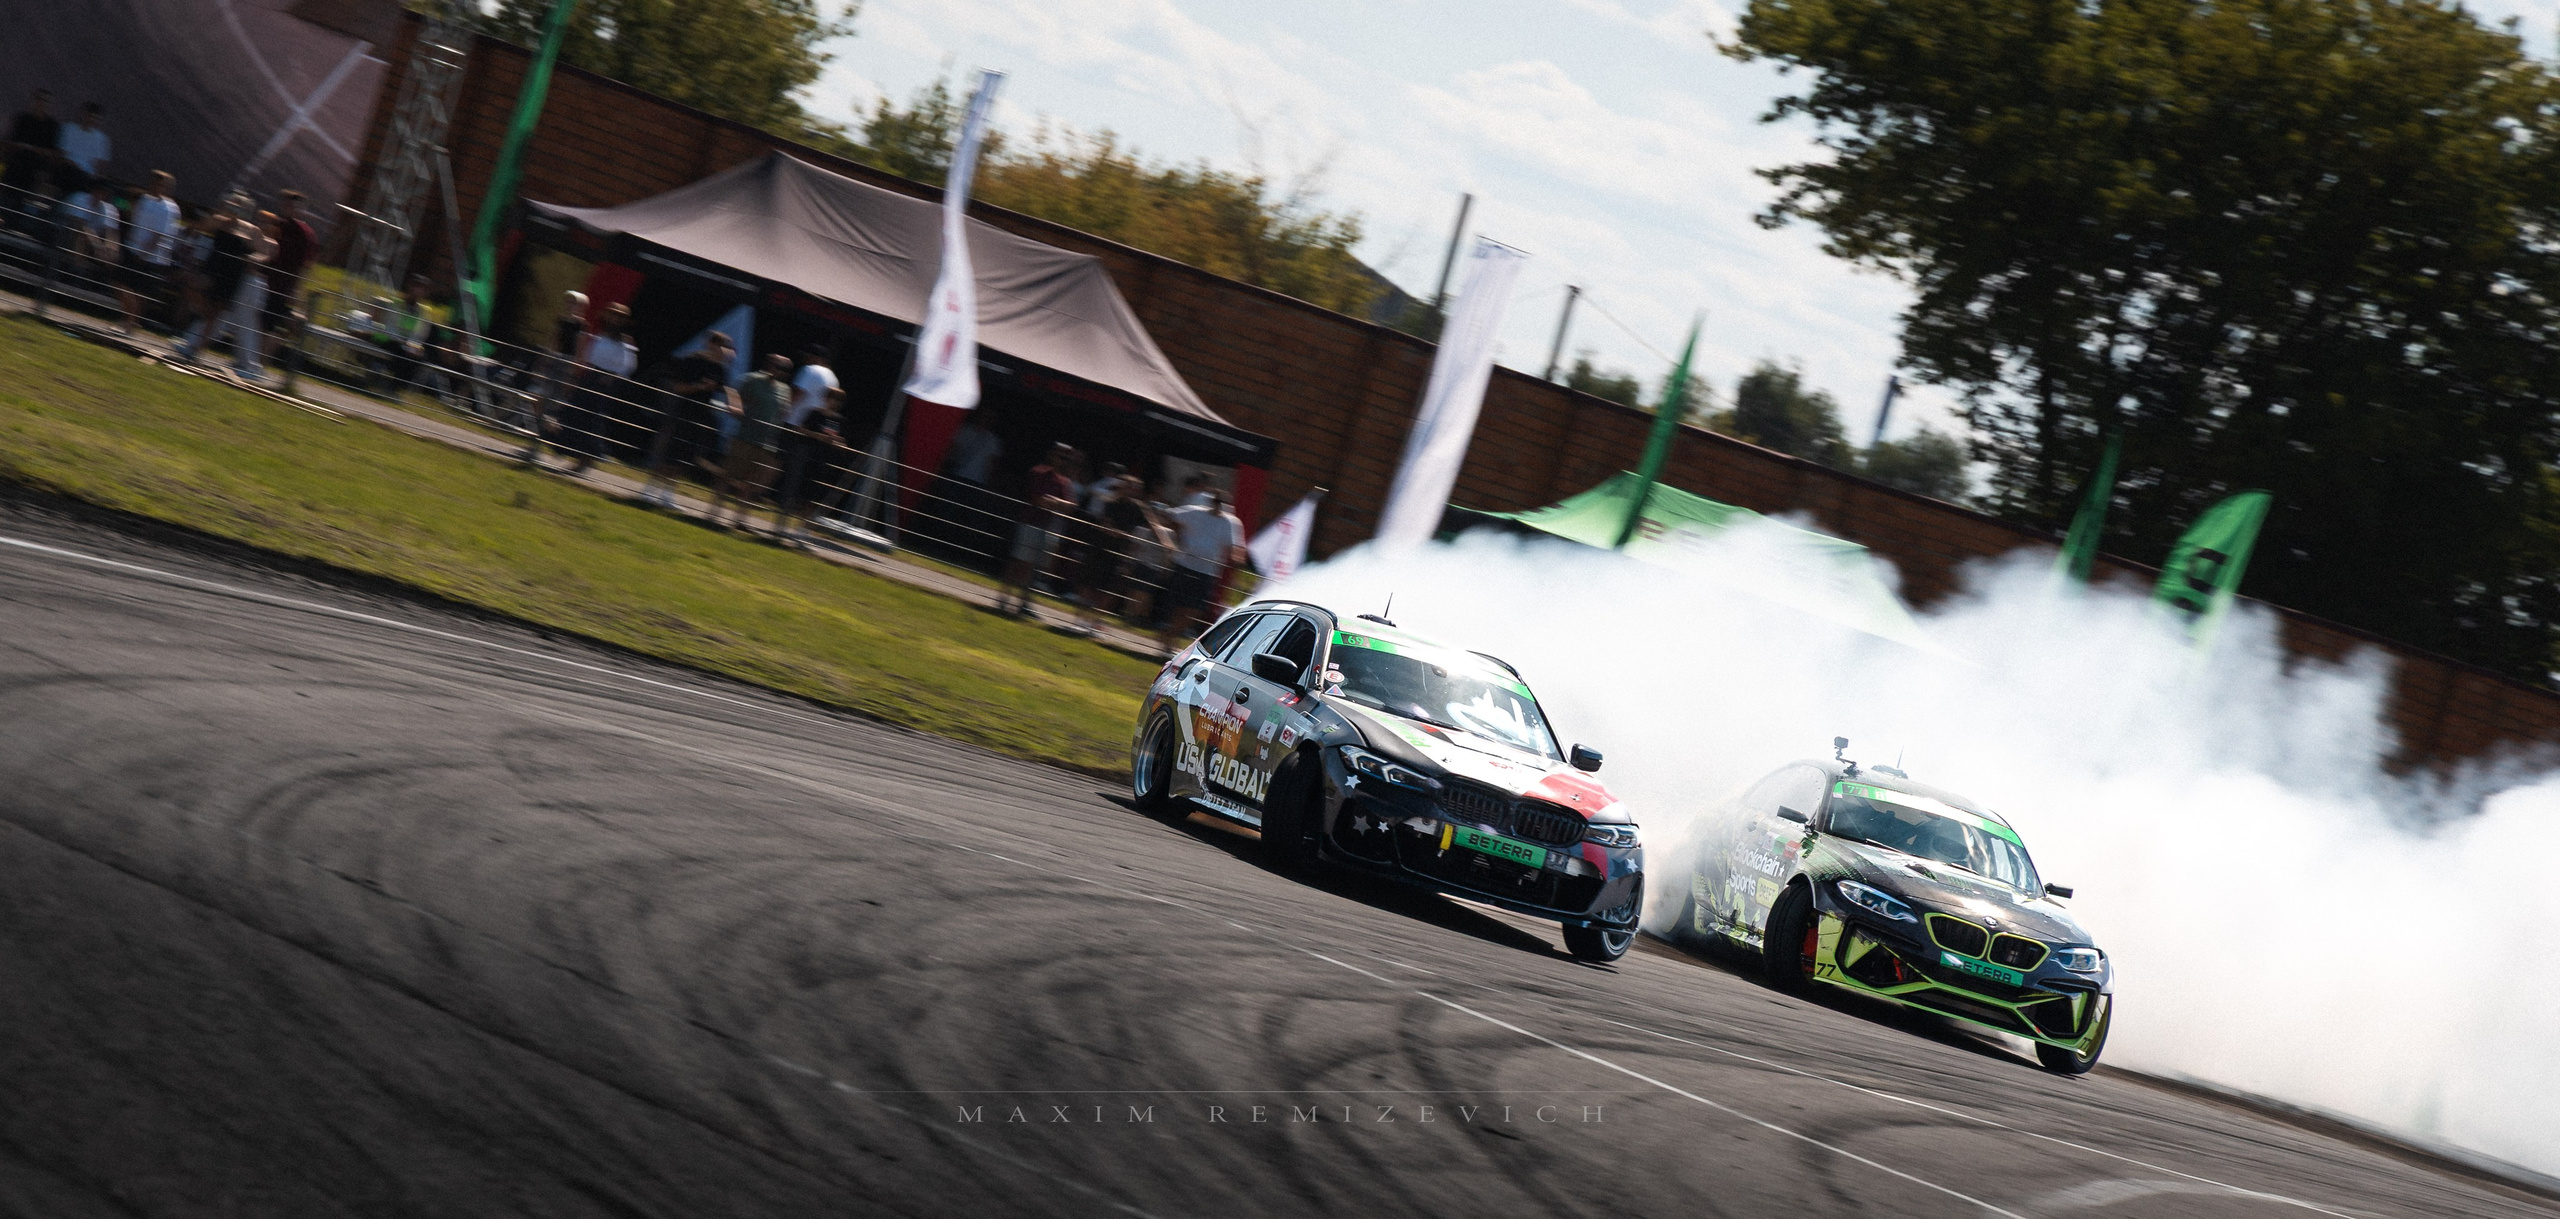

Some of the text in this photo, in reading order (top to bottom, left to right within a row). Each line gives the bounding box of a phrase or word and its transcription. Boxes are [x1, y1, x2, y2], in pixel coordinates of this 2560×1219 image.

[1347, 635, 1364, 646] 69
[1199, 703, 1244, 734] CHAMPION
[1176, 741, 1266, 801] USA GLOBAL
[1846, 785, 1864, 795] 77
[1734, 842, 1780, 877] Blockchain
[1729, 866, 1757, 896] Sports
[1816, 962, 1837, 977] 77
